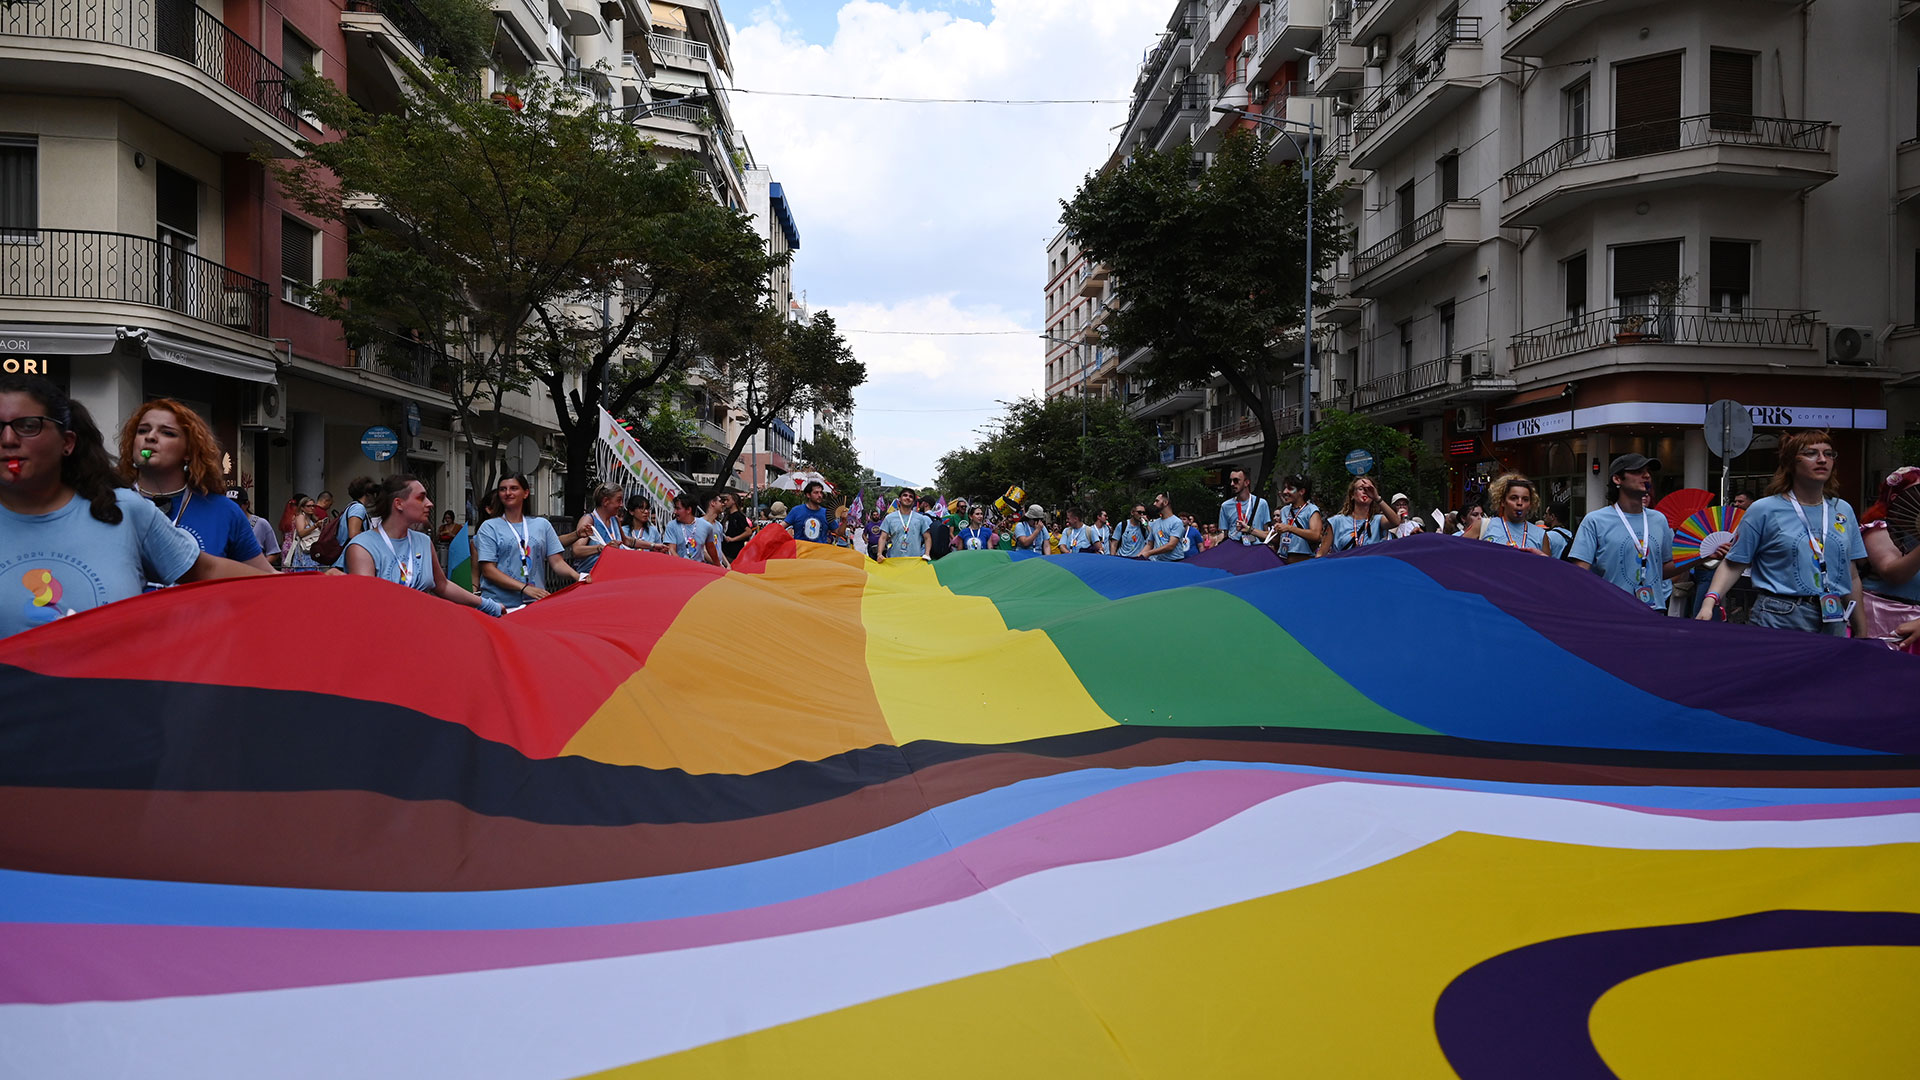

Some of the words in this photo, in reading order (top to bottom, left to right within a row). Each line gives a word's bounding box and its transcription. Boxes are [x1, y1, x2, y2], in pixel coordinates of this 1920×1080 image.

[3, 358, 48, 374] ORI
[1542, 418, 1564, 427] corner
[16, 552, 44, 560] 2024
[51, 552, 106, 595] THESSALONIKI
